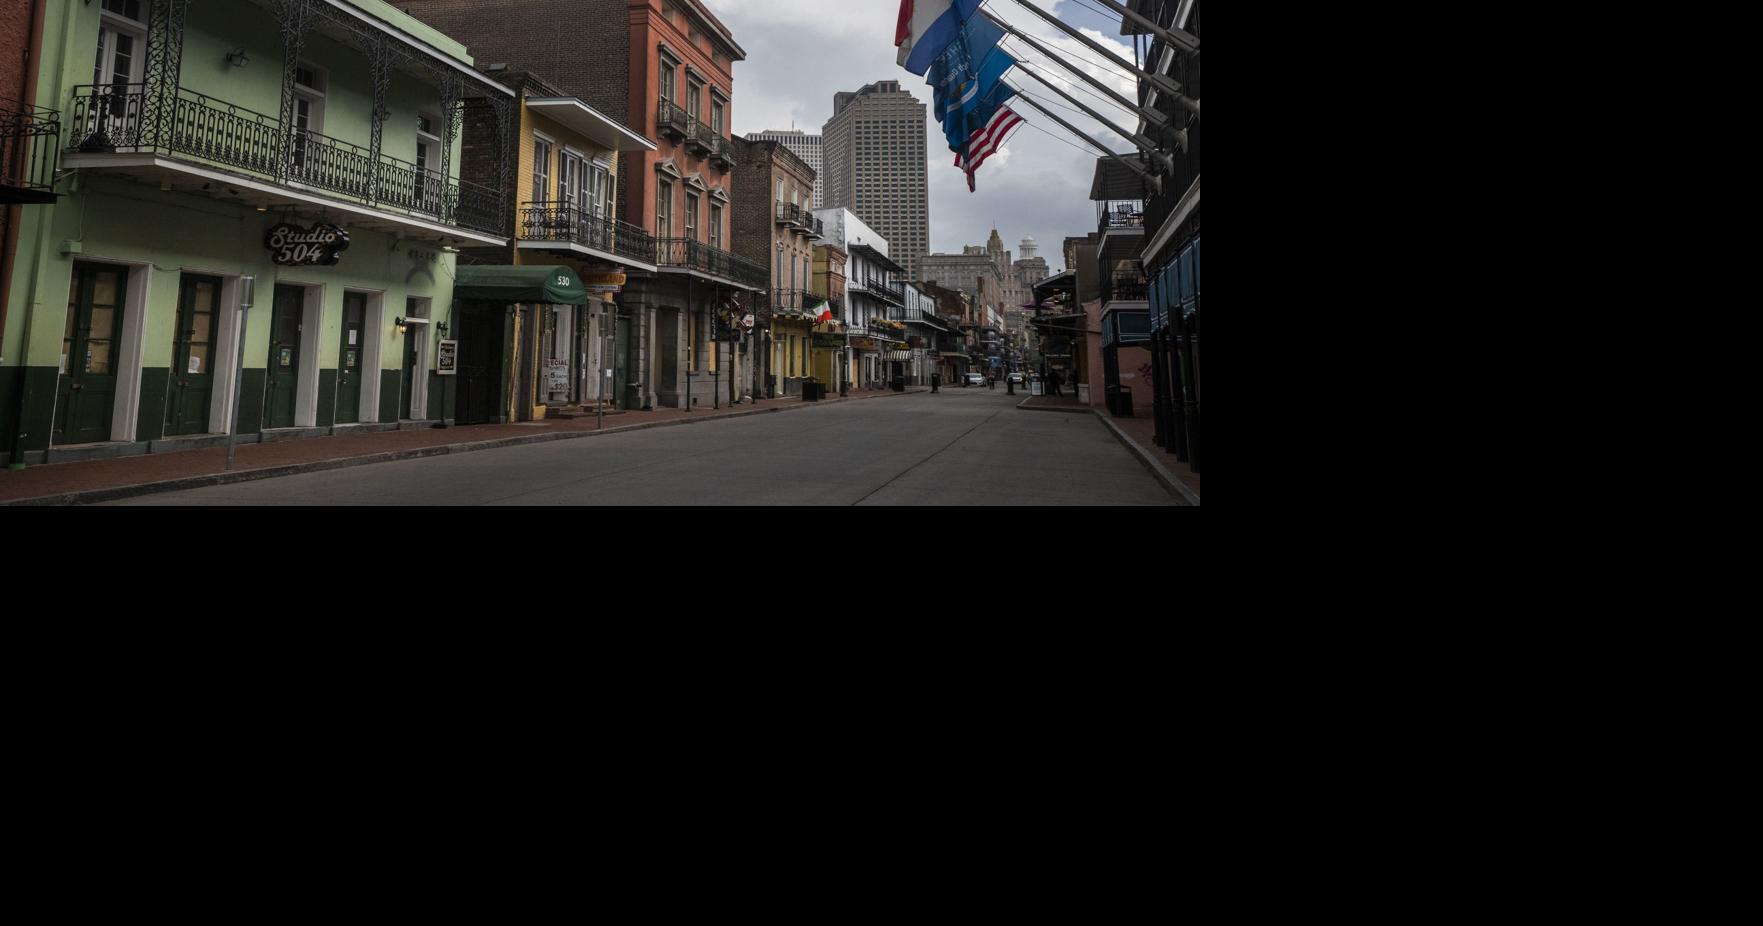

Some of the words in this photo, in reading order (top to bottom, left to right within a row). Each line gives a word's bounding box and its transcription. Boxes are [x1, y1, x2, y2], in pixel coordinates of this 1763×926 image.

[270, 227, 336, 248] Studio
[278, 244, 323, 262] 504
[558, 275, 570, 287] 530
